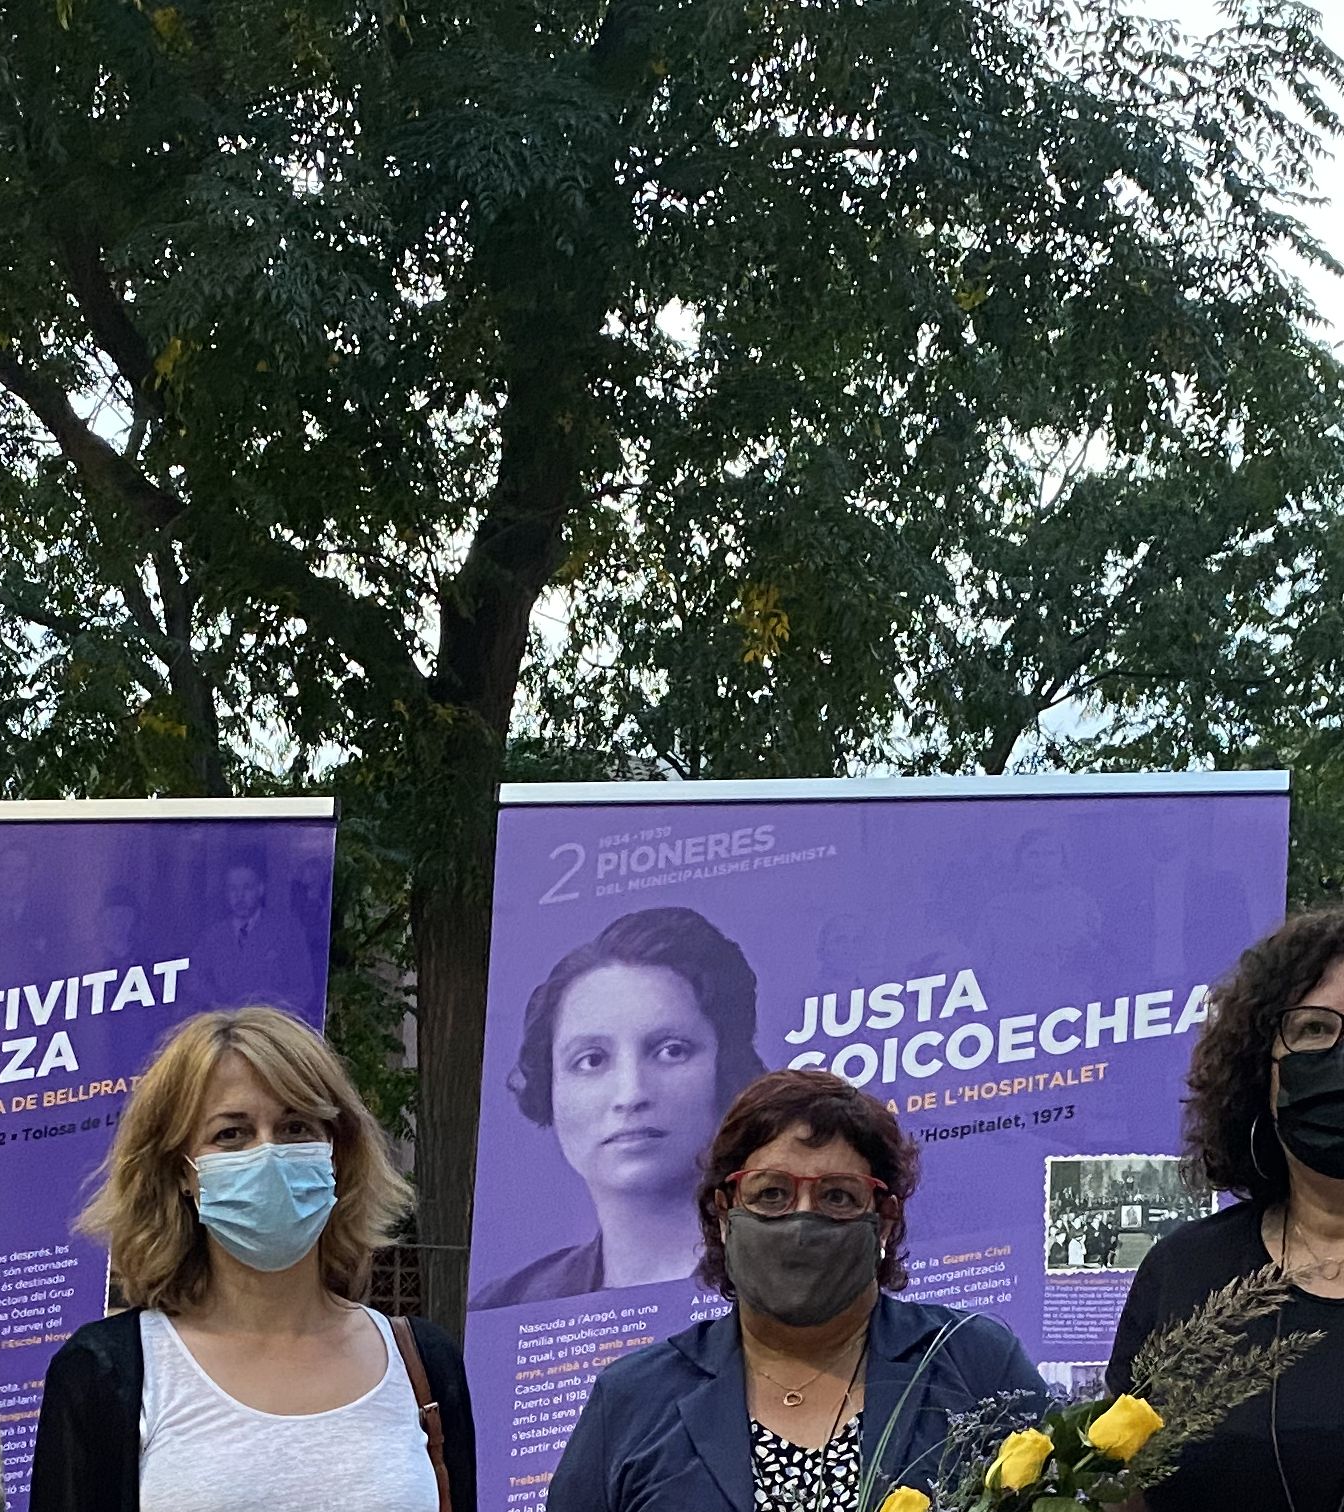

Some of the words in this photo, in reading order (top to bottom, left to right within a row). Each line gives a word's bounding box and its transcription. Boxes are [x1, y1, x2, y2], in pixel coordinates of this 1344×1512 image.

[599, 833, 630, 848] 1934
[639, 826, 672, 841] 1939
[596, 824, 776, 880] PIONERES
[538, 842, 586, 905] 2
[595, 883, 624, 897] DEL
[628, 860, 749, 890] MUNICIPALISME
[753, 845, 838, 870] FEMINISTA
[784, 968, 989, 1044] JUSTA
[906, 1093, 937, 1114] DE
[944, 1063, 1110, 1105] L'HOSPITALET
[12, 1094, 37, 1113] DE
[22, 1123, 76, 1141] Tolosa
[81, 1116, 100, 1132] de
[911, 1114, 1026, 1144] 'Hospitalet,
[1032, 1105, 1075, 1125] 1973
[912, 1260, 926, 1270] de
[928, 1257, 939, 1267] la
[923, 1263, 1006, 1283] reorganització
[963, 1277, 1010, 1291] catalans
[31, 1292, 47, 1302] del
[48, 1304, 61, 1314] de
[519, 1318, 566, 1334] Nascuda
[568, 1319, 575, 1327] a
[620, 1308, 635, 1316] en
[638, 1305, 658, 1315] una
[556, 1325, 619, 1344] republicana
[622, 1321, 647, 1332] amb
[517, 1354, 527, 1365] la
[558, 1347, 568, 1358] el
[571, 1344, 596, 1356] 1908
[514, 1396, 550, 1410] Puerto
[553, 1393, 563, 1404] el
